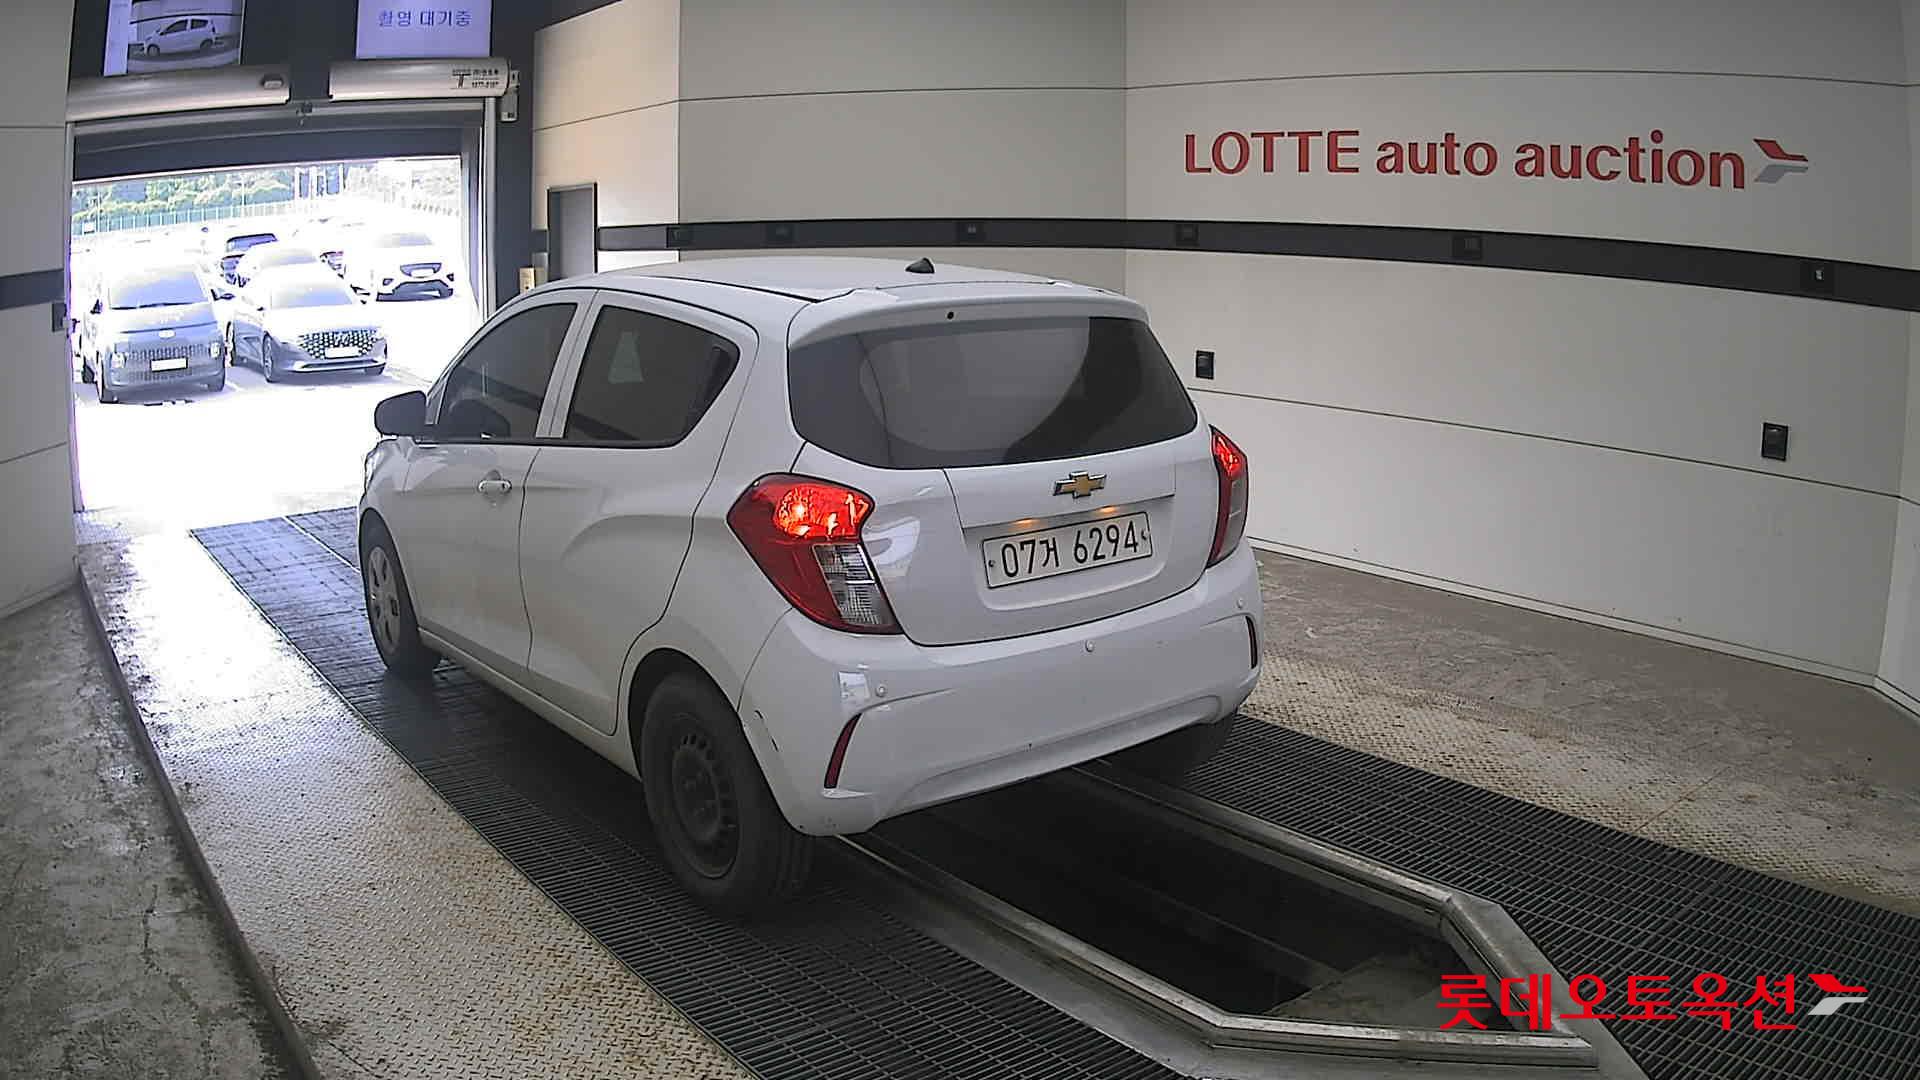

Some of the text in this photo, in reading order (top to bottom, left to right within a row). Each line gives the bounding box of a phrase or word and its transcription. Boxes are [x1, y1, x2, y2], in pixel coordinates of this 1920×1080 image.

[420, 9, 471, 27] 대기중
[1185, 130, 1744, 189] LOTTE auto auction
[1001, 520, 1139, 577] 07거 6294
